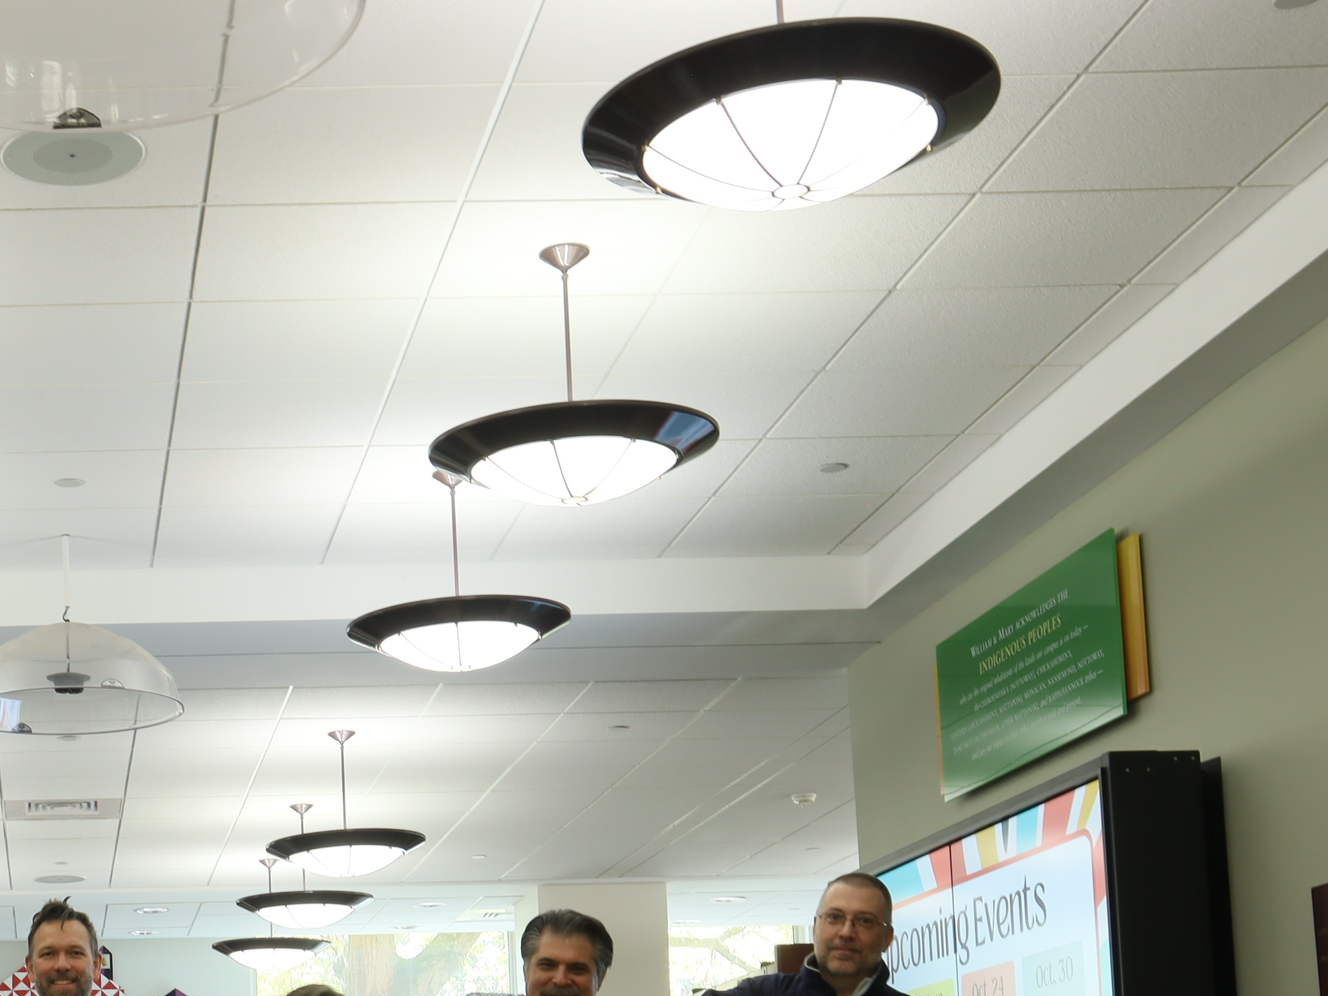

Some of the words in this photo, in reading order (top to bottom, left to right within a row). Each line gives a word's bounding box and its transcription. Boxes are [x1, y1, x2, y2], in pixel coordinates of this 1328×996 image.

[979, 635, 1026, 675] INDIGENOUS
[1028, 613, 1061, 645] PEOPLES
[992, 636, 997, 644] &
[998, 625, 1014, 640] MARY
[1057, 588, 1070, 604] THE
[890, 904, 969, 984] pcoming
[973, 875, 1047, 947] Events
[1036, 964, 1057, 988] Oct.
[1058, 956, 1074, 982] 30
